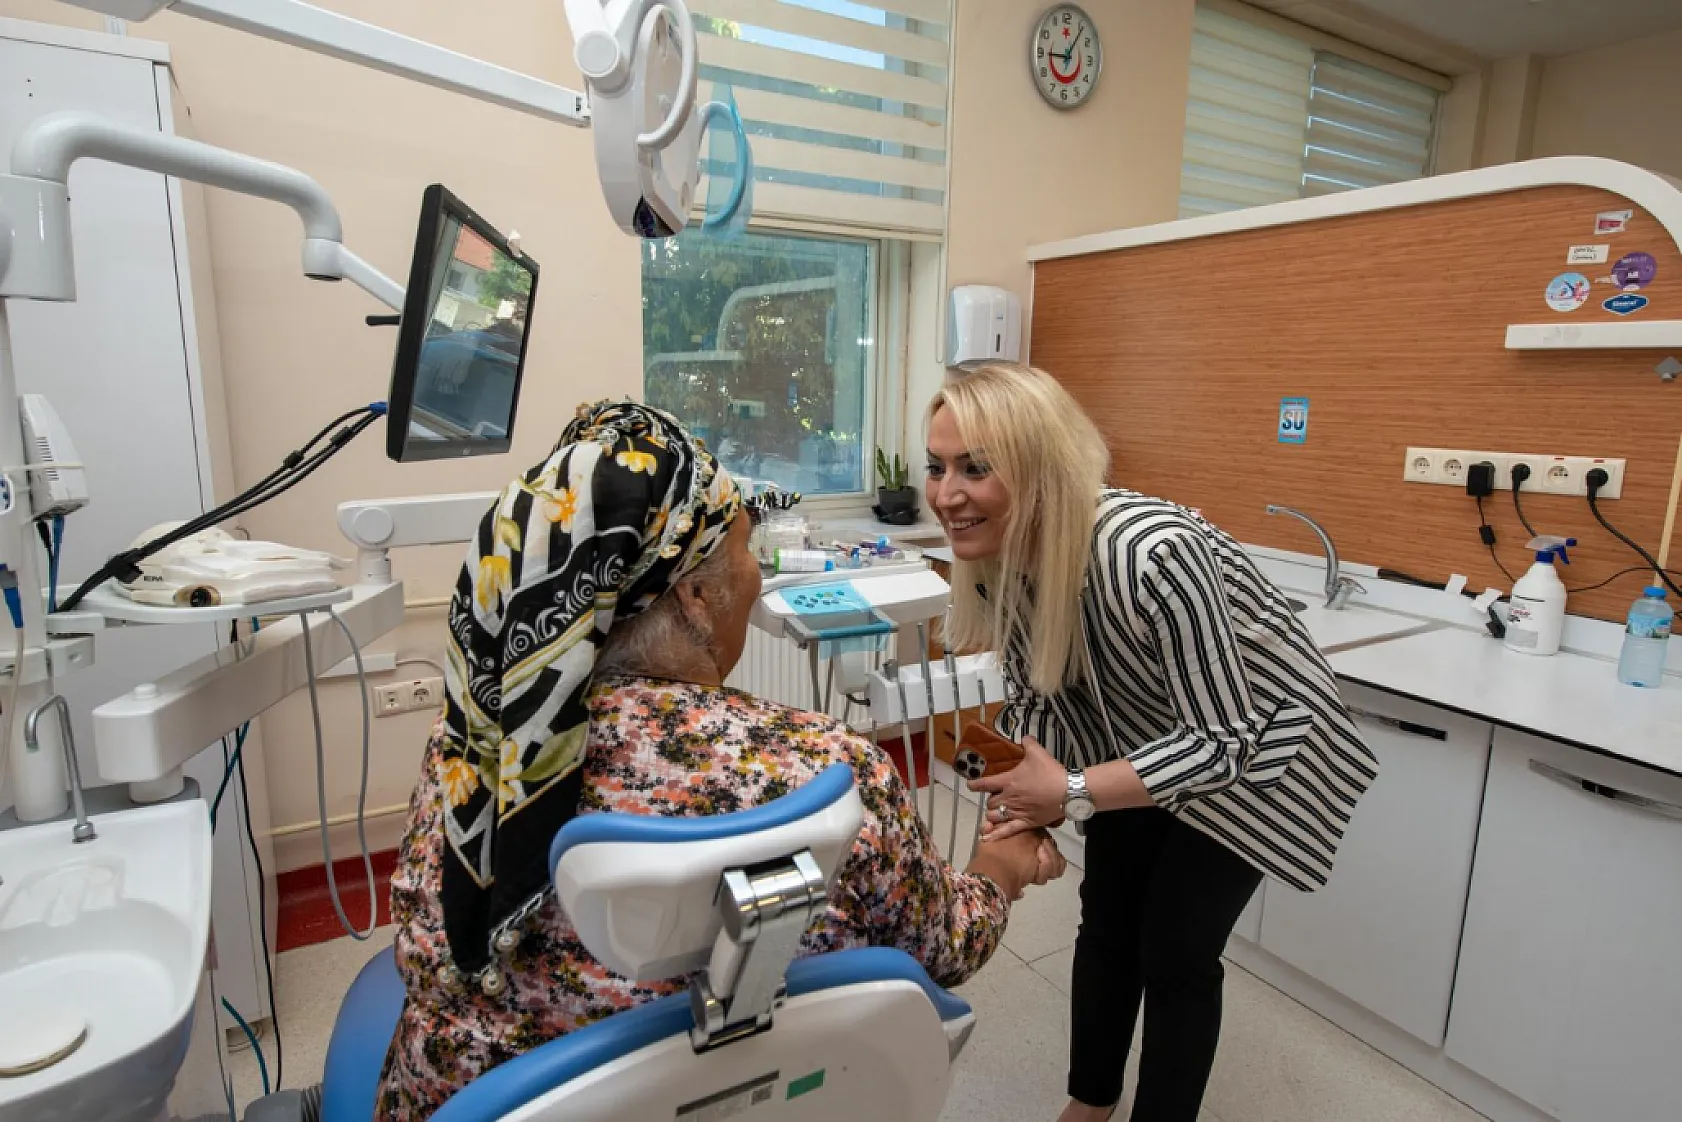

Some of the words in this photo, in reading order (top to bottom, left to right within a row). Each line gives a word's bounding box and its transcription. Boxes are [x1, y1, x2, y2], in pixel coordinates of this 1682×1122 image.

[1052, 16, 1057, 26] 11
[1062, 12, 1072, 25] 12
[1041, 29, 1049, 39] 10
[1084, 37, 1090, 47] 2
[1037, 47, 1044, 59] 9
[1087, 55, 1093, 67] 3
[1040, 67, 1047, 77] 8
[1083, 74, 1088, 82] 4
[1050, 83, 1056, 93] 7
[1074, 86, 1080, 97] 5
[1060, 89, 1067, 100] 6
